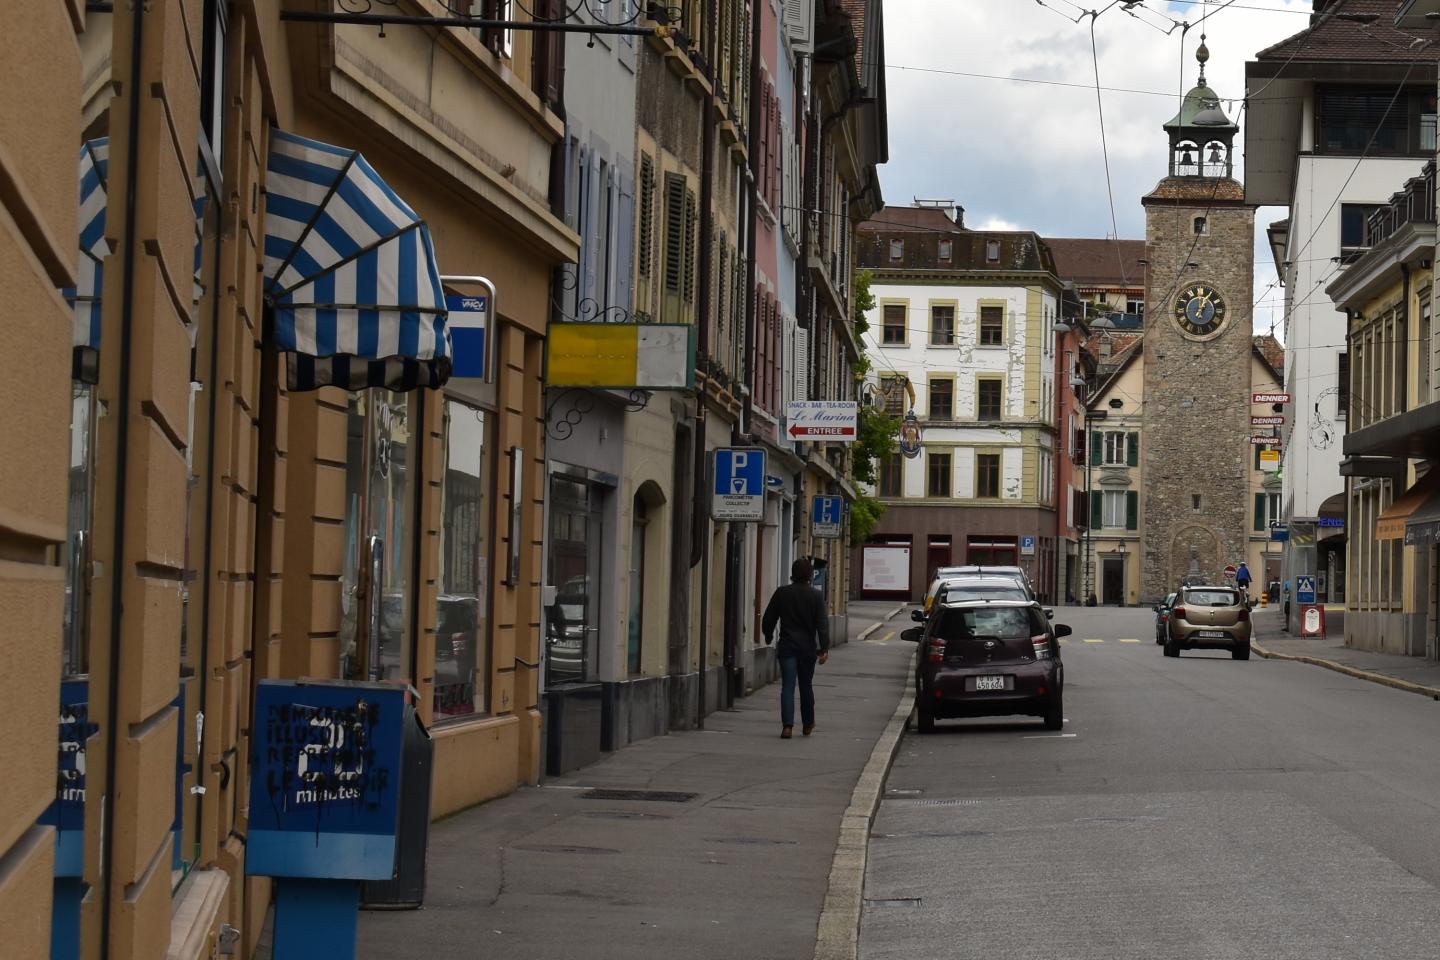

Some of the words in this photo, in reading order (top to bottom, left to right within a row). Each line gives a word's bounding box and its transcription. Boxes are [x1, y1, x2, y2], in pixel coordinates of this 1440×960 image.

[789, 410, 807, 421] Le
[813, 410, 857, 421] Marina
[732, 452, 748, 477] P
[823, 498, 832, 513] P
[977, 682, 990, 690] 450
